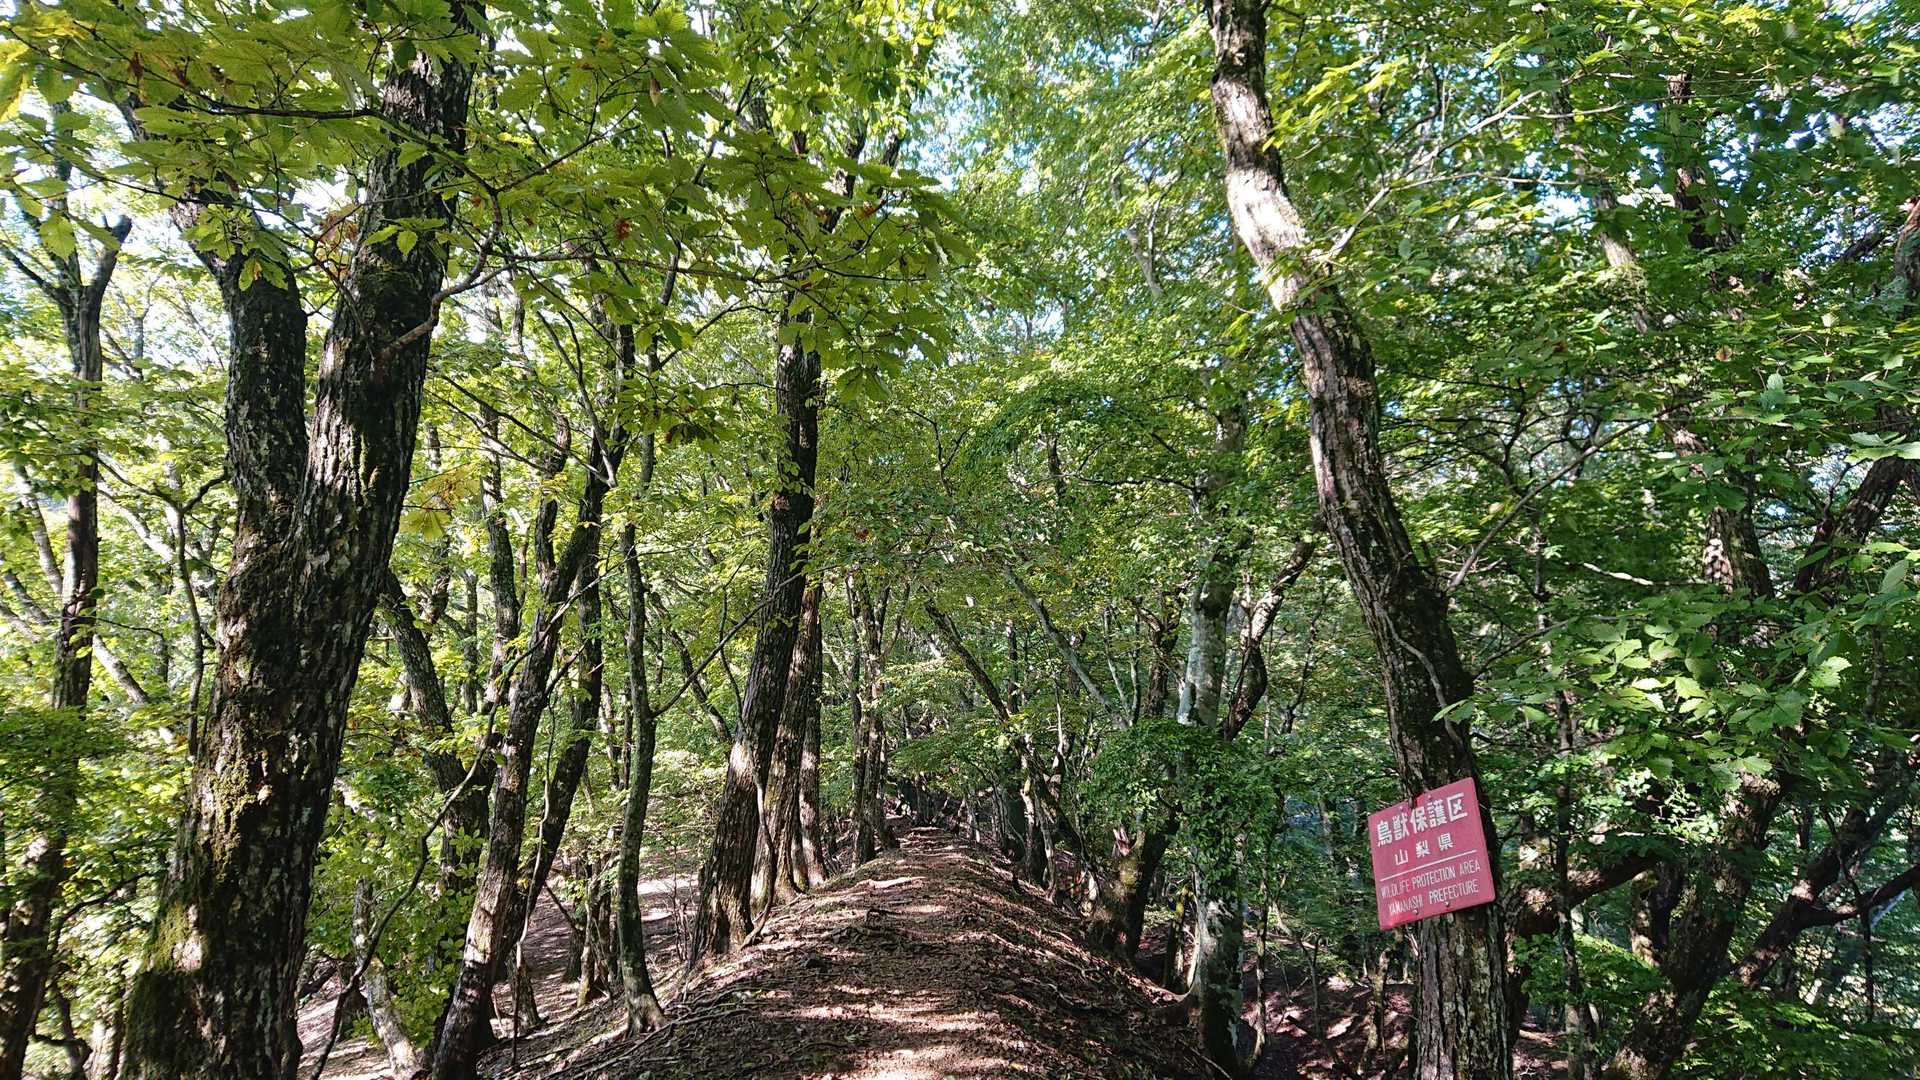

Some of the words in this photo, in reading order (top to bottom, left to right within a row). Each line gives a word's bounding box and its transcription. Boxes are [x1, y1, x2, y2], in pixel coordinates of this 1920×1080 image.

[1377, 792, 1468, 847] 鳥獣保護区
[1380, 881, 1410, 899] WILDLIFE
[1412, 866, 1456, 889] PROTECTION
[1459, 859, 1481, 876] AREA
[1388, 895, 1423, 916] YAMANASHI
[1429, 879, 1479, 905] PREFECTURE
